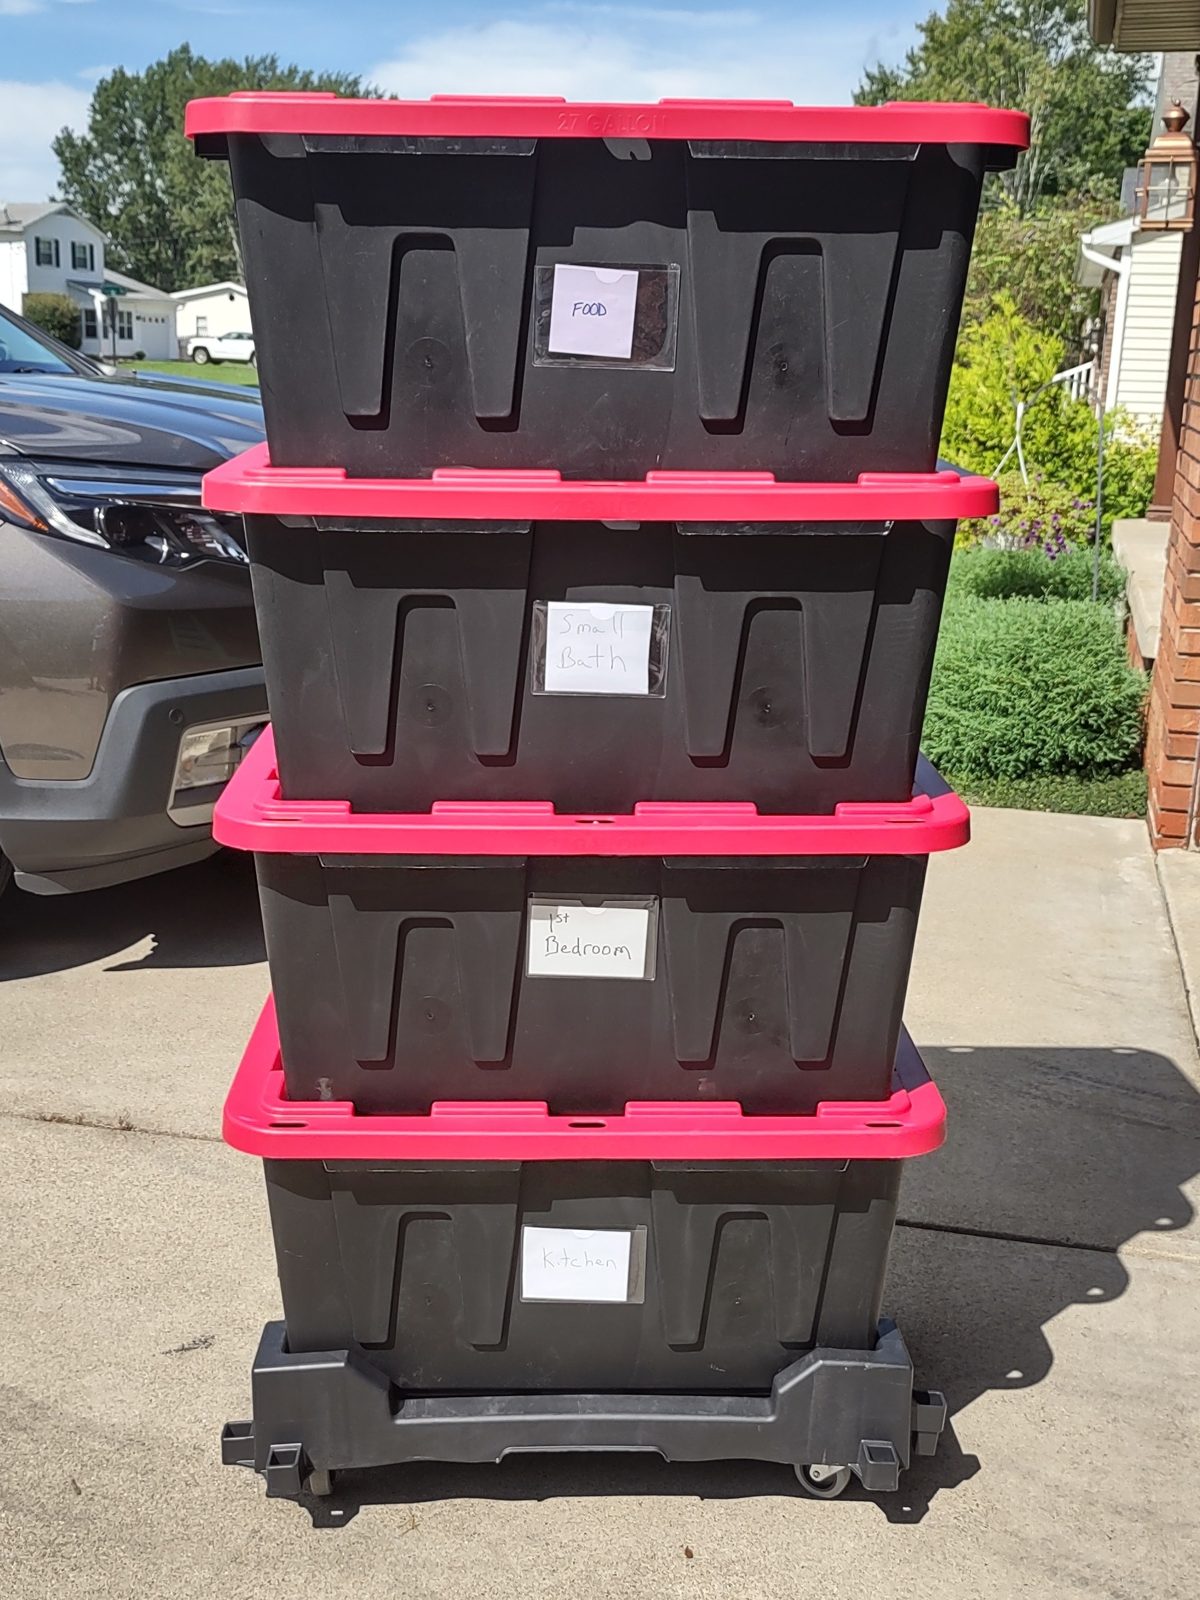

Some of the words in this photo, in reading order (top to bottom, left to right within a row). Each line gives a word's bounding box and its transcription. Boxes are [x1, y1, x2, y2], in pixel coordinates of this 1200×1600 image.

[556, 112, 580, 131] 27
[586, 113, 669, 133] GALLON
[572, 302, 607, 317] FOOD
[560, 613, 624, 639] Small
[556, 643, 627, 673] Bath
[549, 912, 571, 933] 1st
[544, 935, 632, 960] Bedroom
[542, 1247, 617, 1270] Kitchen
